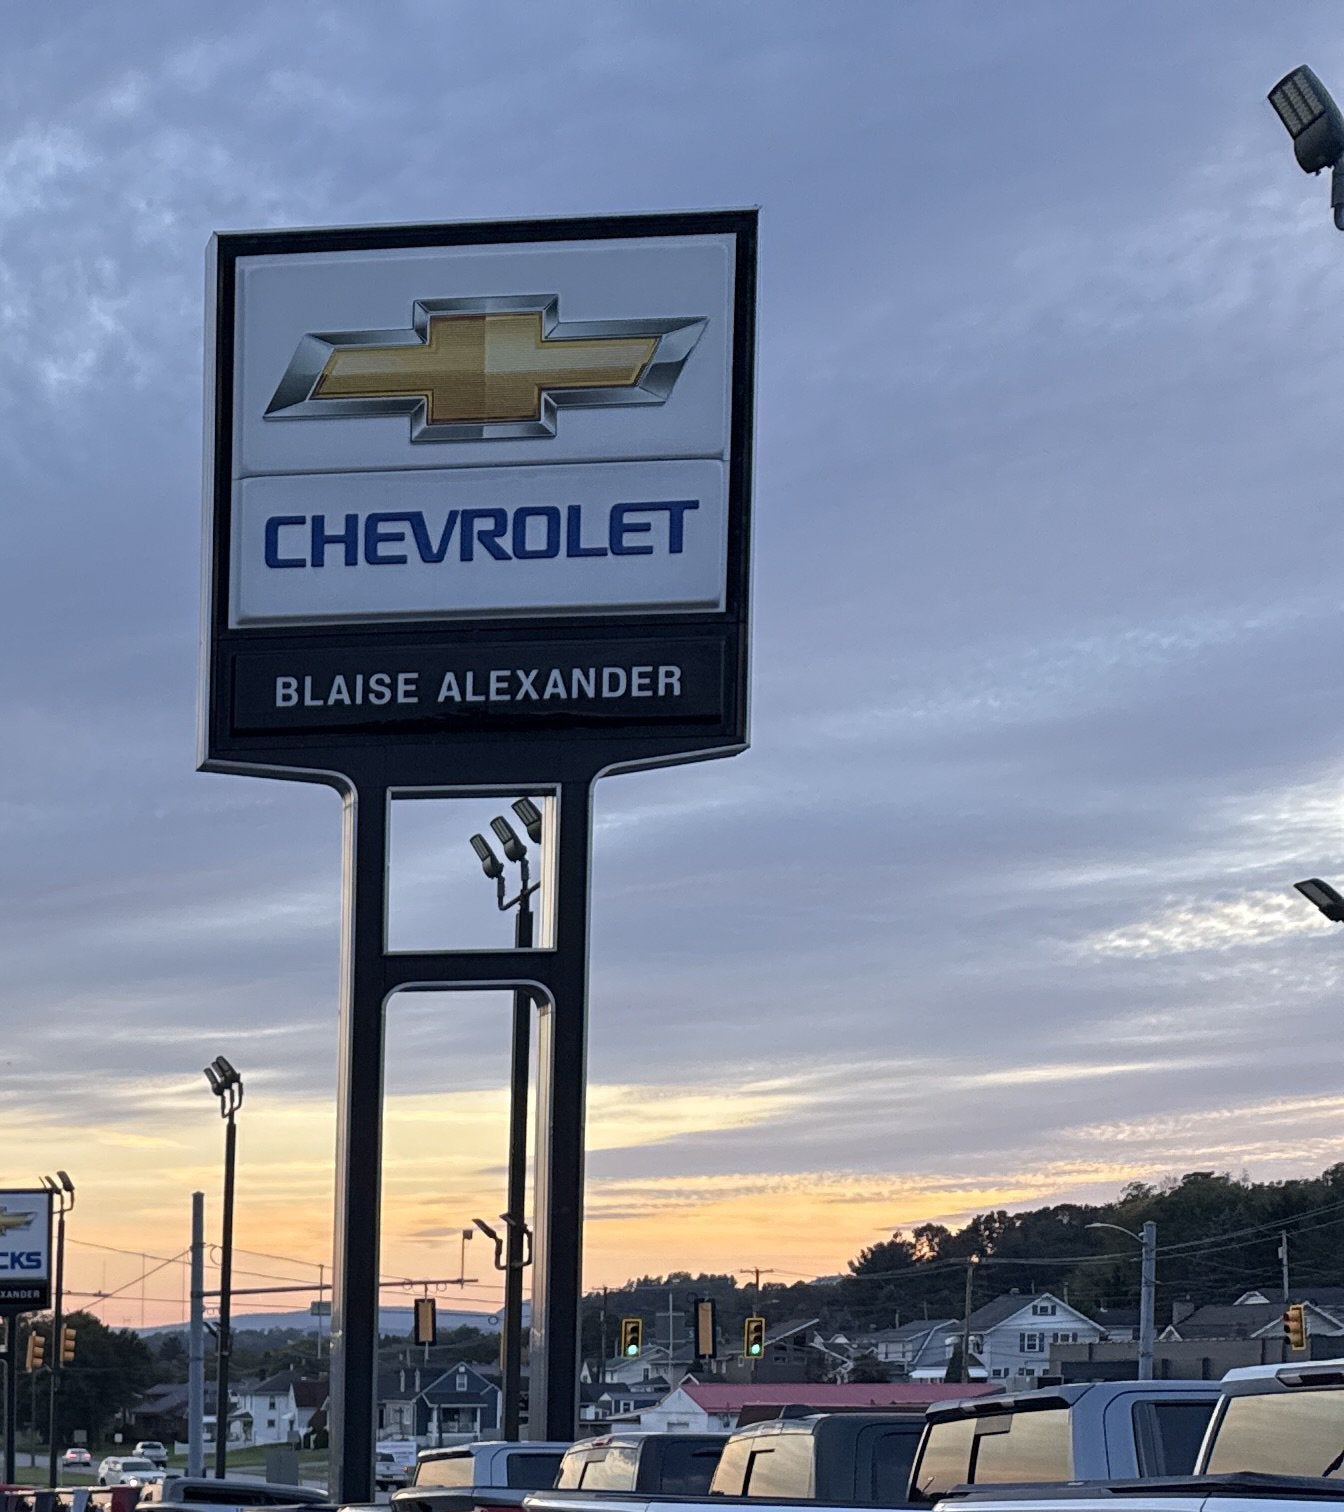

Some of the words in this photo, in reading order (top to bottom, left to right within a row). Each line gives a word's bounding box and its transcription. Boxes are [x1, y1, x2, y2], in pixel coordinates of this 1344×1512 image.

[264, 499, 700, 569] CHEVROLET
[274, 672, 419, 708] BLAISE
[437, 665, 683, 703] ALEXANDER
